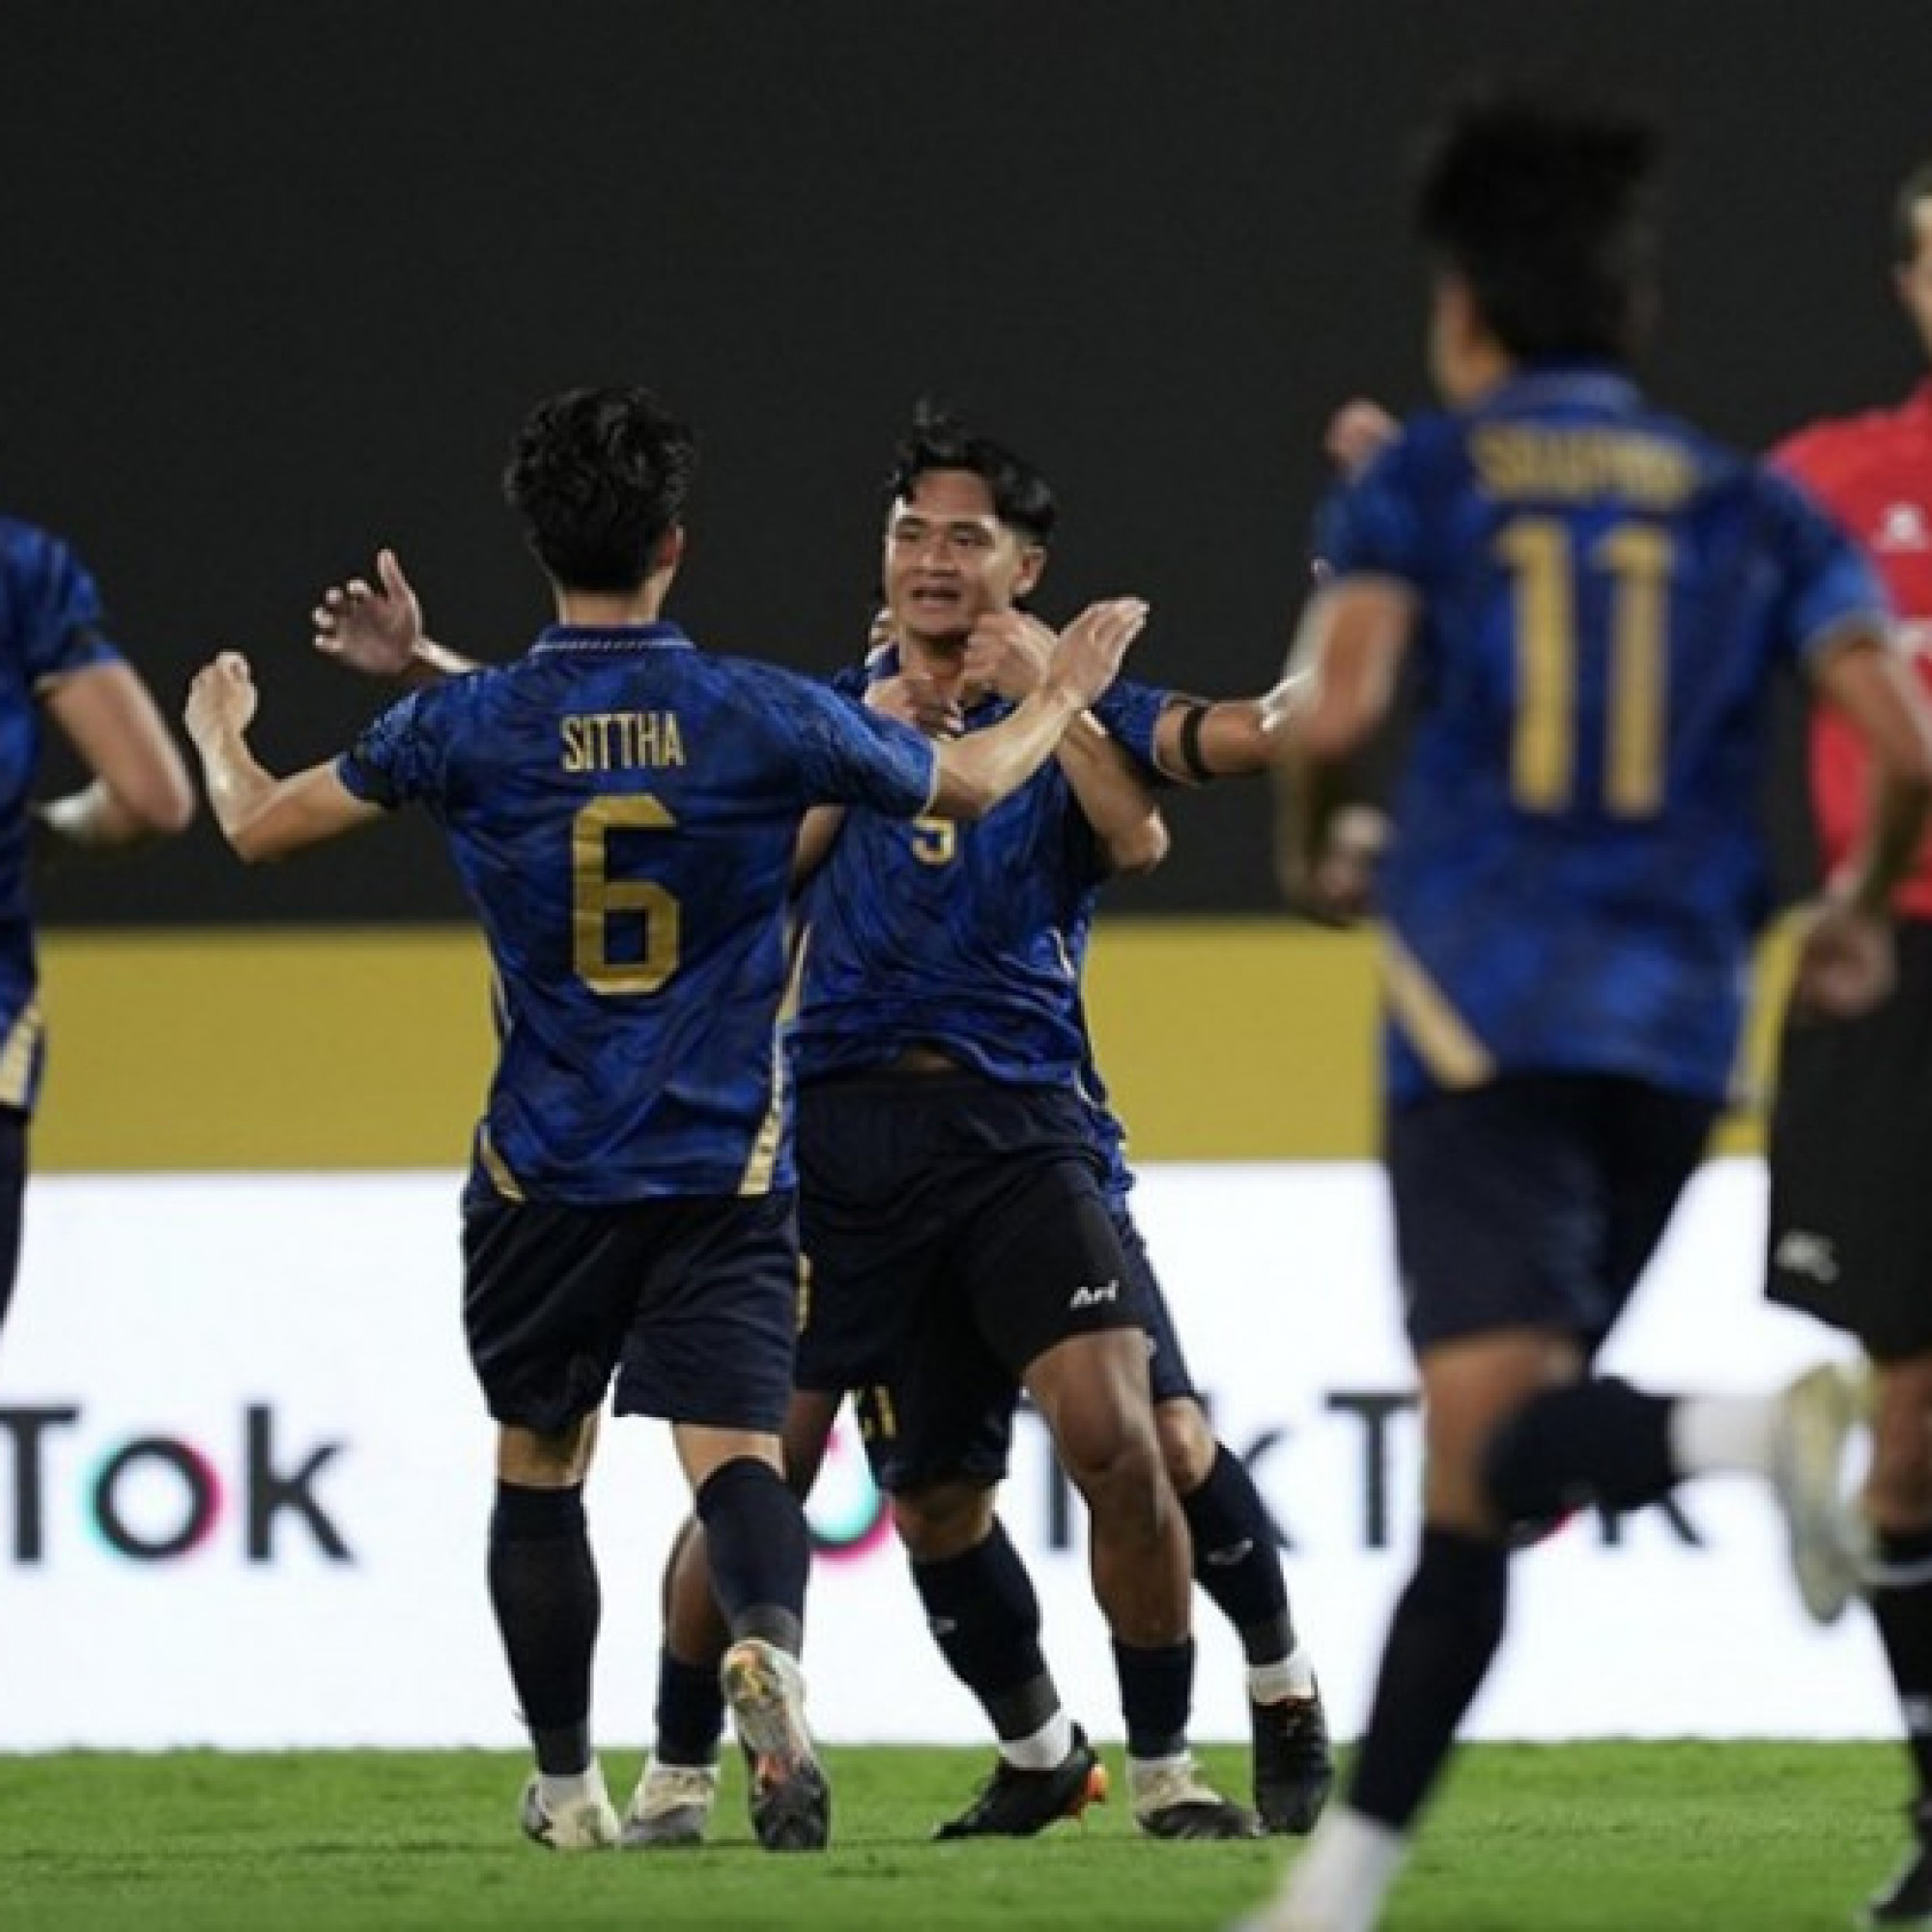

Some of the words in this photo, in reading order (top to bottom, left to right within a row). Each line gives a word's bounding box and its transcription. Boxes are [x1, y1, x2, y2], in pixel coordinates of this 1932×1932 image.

[560, 711, 685, 772] SITTHA
[1493, 519, 1675, 818] 11
[572, 793, 680, 996] 6
